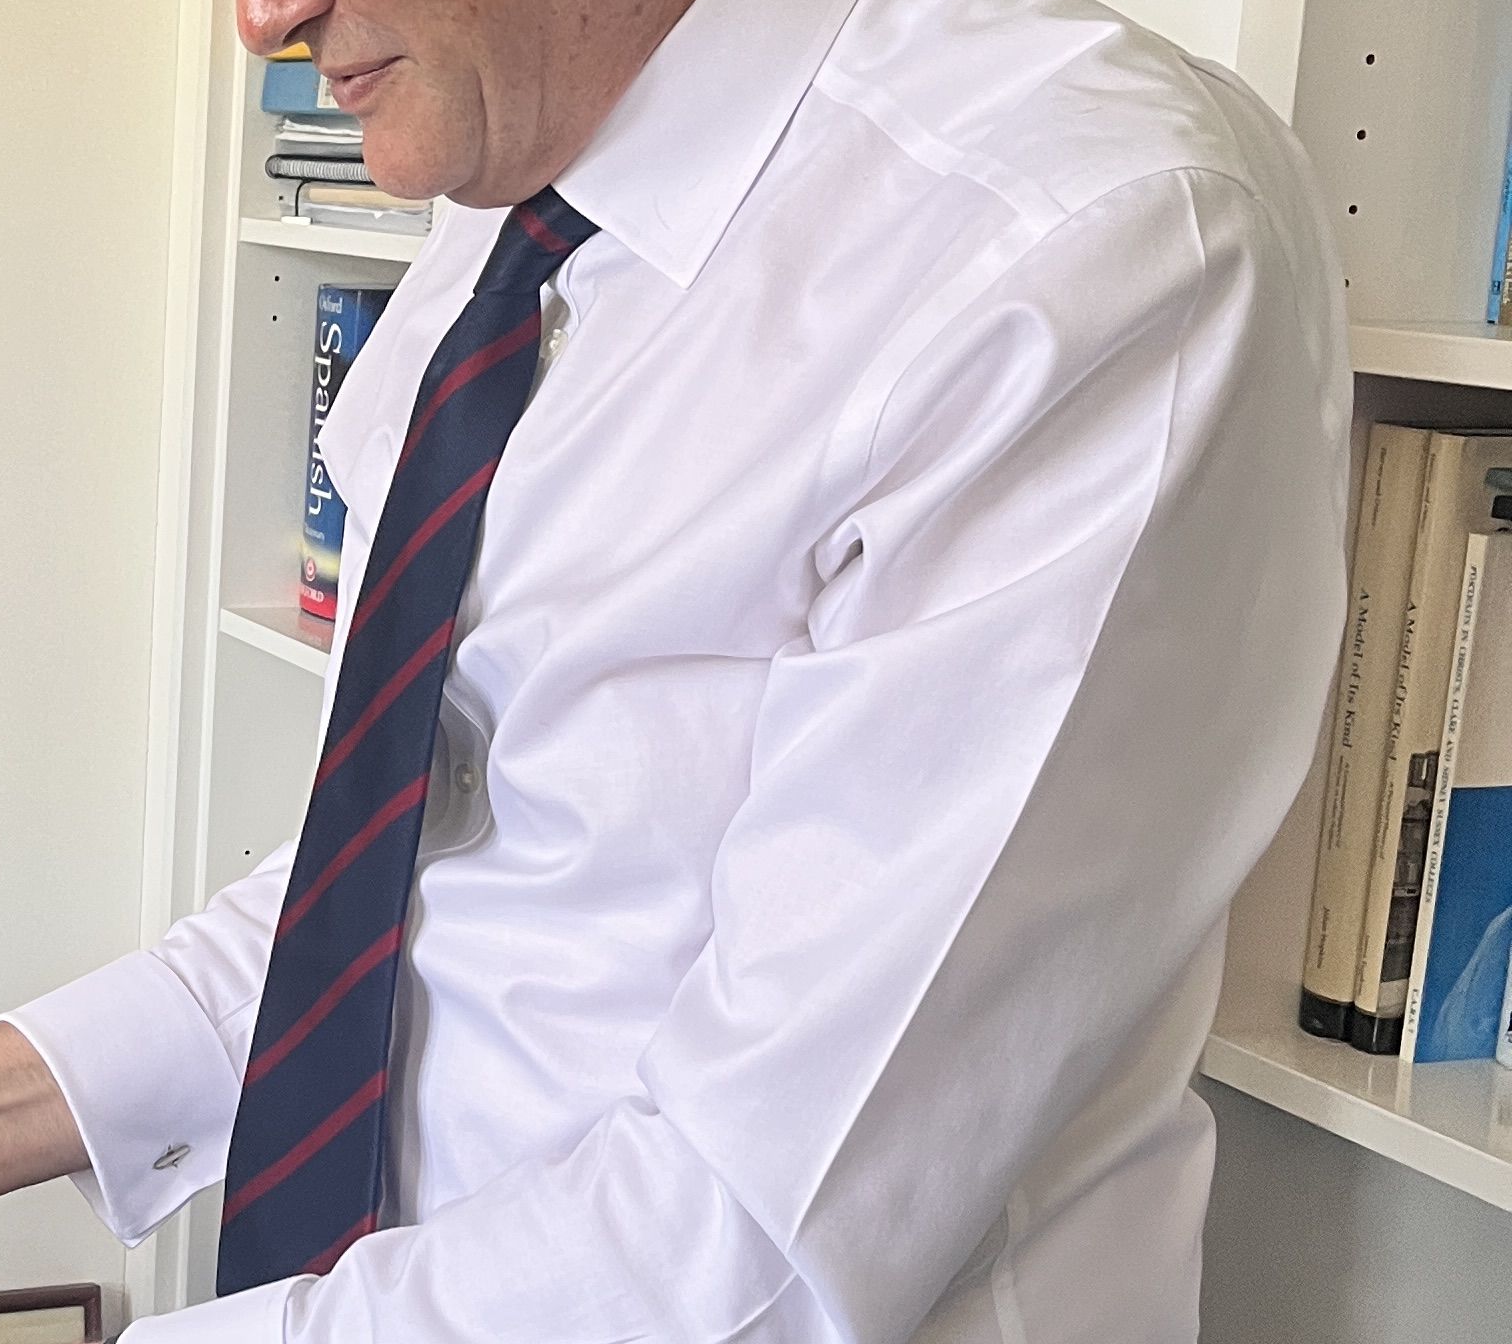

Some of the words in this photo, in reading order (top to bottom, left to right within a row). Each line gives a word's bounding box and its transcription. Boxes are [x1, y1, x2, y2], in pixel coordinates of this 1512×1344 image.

[1360, 587, 1370, 601] A
[1407, 600, 1417, 612] A
[1353, 608, 1368, 659] Model
[1400, 618, 1415, 671] Model
[1350, 662, 1361, 681] of
[1347, 681, 1359, 704] Its
[1342, 709, 1356, 748] Kind
[1448, 698, 1460, 736] CLARE
[1444, 739, 1454, 762] AND
[1437, 765, 1450, 804] SIDNEY
[1431, 807, 1444, 848] SUSSEX
[1425, 850, 1439, 904] COLLEGES
